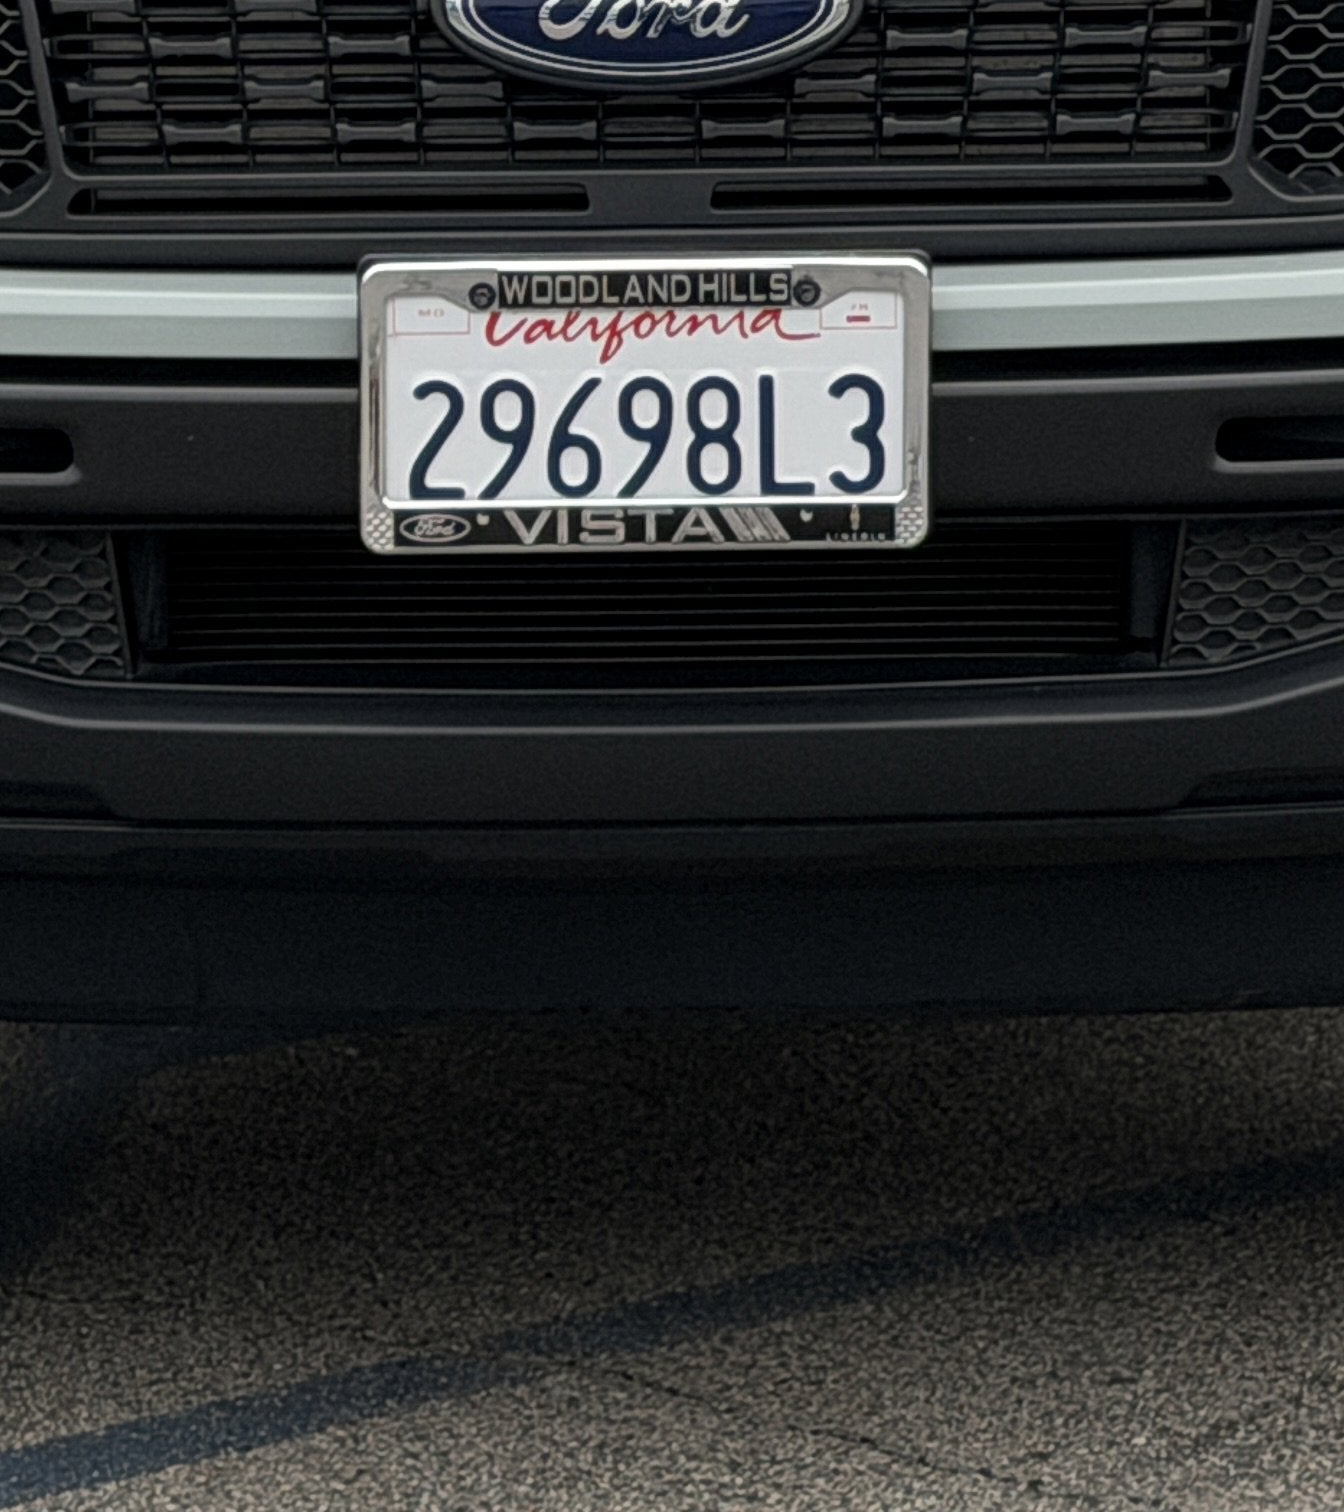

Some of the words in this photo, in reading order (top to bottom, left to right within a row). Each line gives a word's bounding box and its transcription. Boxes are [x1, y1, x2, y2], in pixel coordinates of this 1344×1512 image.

[501, 272, 692, 306] WOODLAND
[698, 271, 790, 303] HILLS
[485, 308, 822, 364] California
[408, 373, 887, 500] 29698L3
[413, 517, 457, 537] Ford
[503, 506, 725, 545] VISTA
